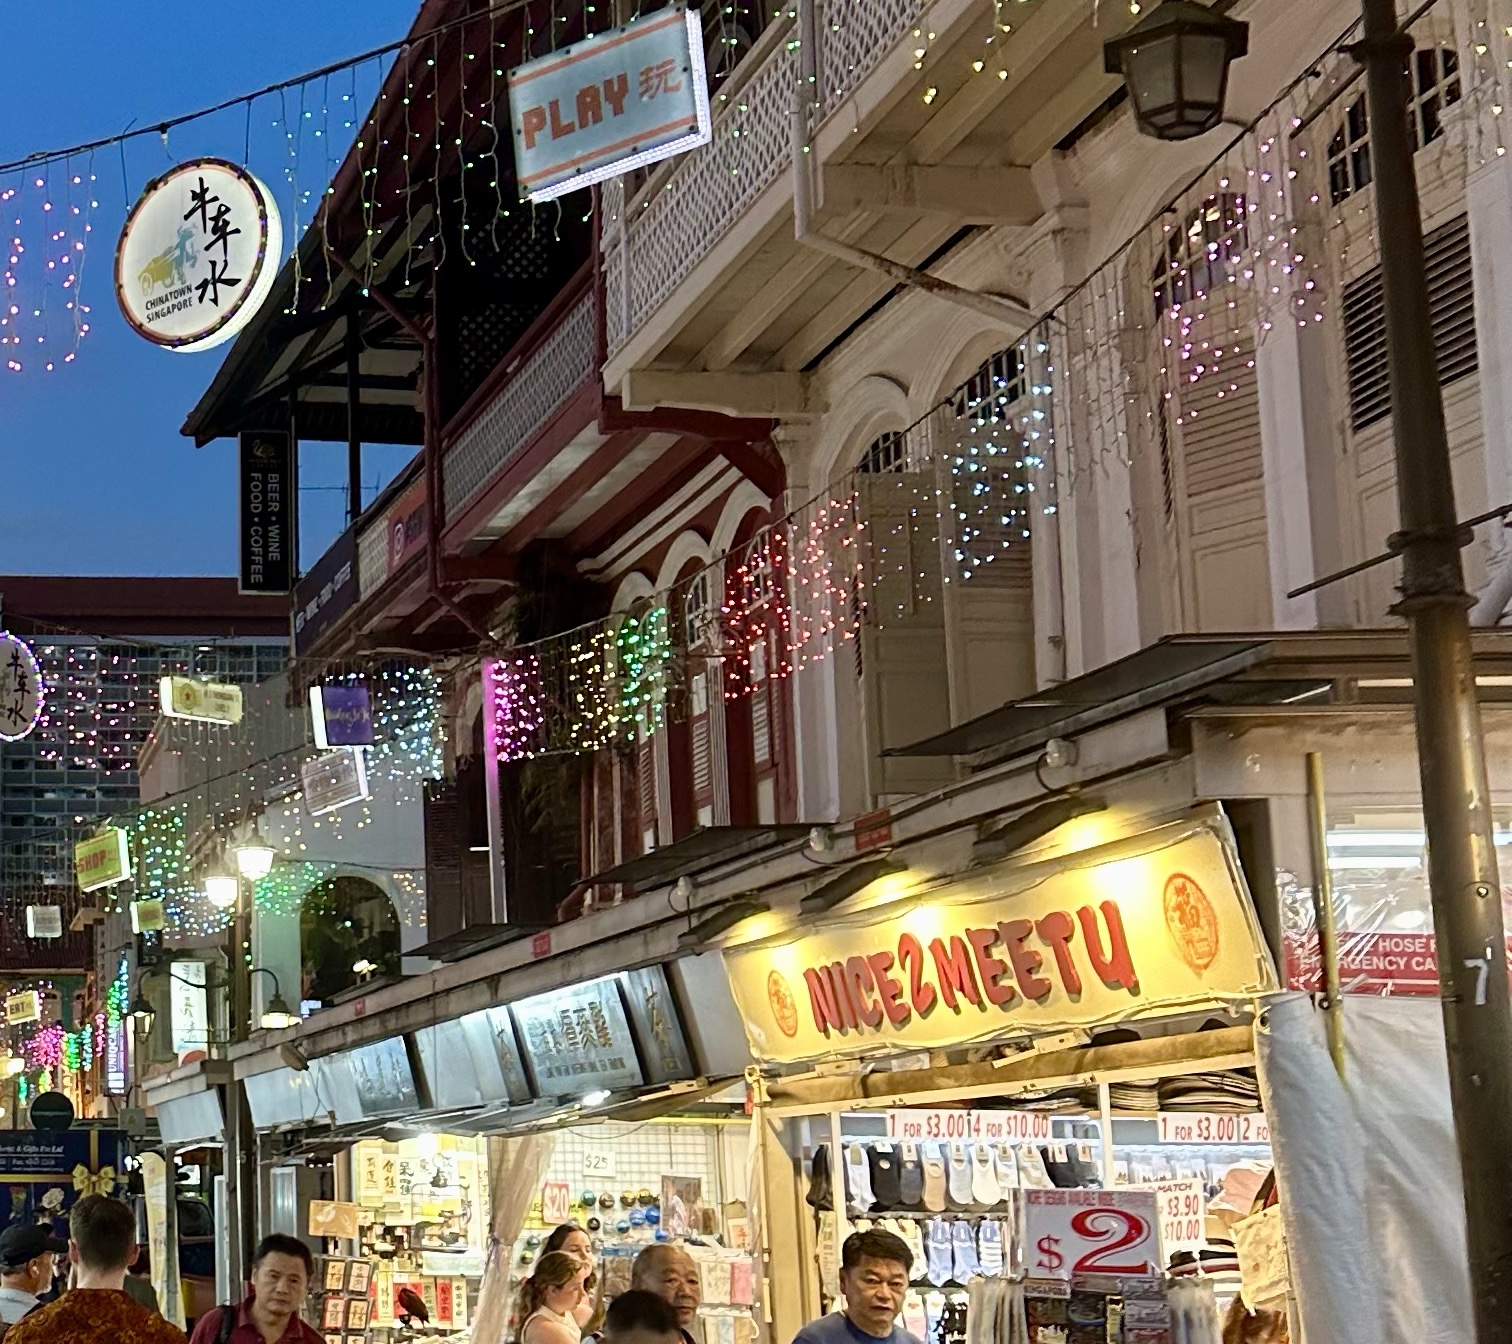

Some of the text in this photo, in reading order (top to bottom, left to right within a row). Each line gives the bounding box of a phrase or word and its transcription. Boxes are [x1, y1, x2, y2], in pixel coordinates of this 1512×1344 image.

[522, 58, 682, 150] PLAY 玩
[184, 177, 241, 307] 牛车水
[145, 283, 193, 311] CHINATOWN
[146, 296, 193, 323] SINGAPORE
[250, 473, 263, 584] FOOD COFFEE
[267, 473, 280, 562] BEER WINE
[6, 647, 31, 727] 牛车水
[77, 849, 106, 874] SHOP
[1378, 938, 1427, 953] HOSE
[803, 900, 1139, 1038] NICE2MEETU
[1301, 957, 1406, 971] EMRGENCY
[890, 1113, 964, 1138] 1 FOR $3.00
[973, 1113, 1049, 1138] 4 FOR $10.00
[1161, 1116, 1235, 1141] 1 FOR $3.00
[1242, 1117, 1269, 1141] 2 FO
[585, 1154, 608, 1170] $25
[1157, 1182, 1193, 1193] MATCH
[544, 1187, 569, 1216] $20
[1167, 1194, 1199, 1218] $3.90
[1037, 1208, 1150, 1273] $2
[1165, 1218, 1200, 1242] $10.00
